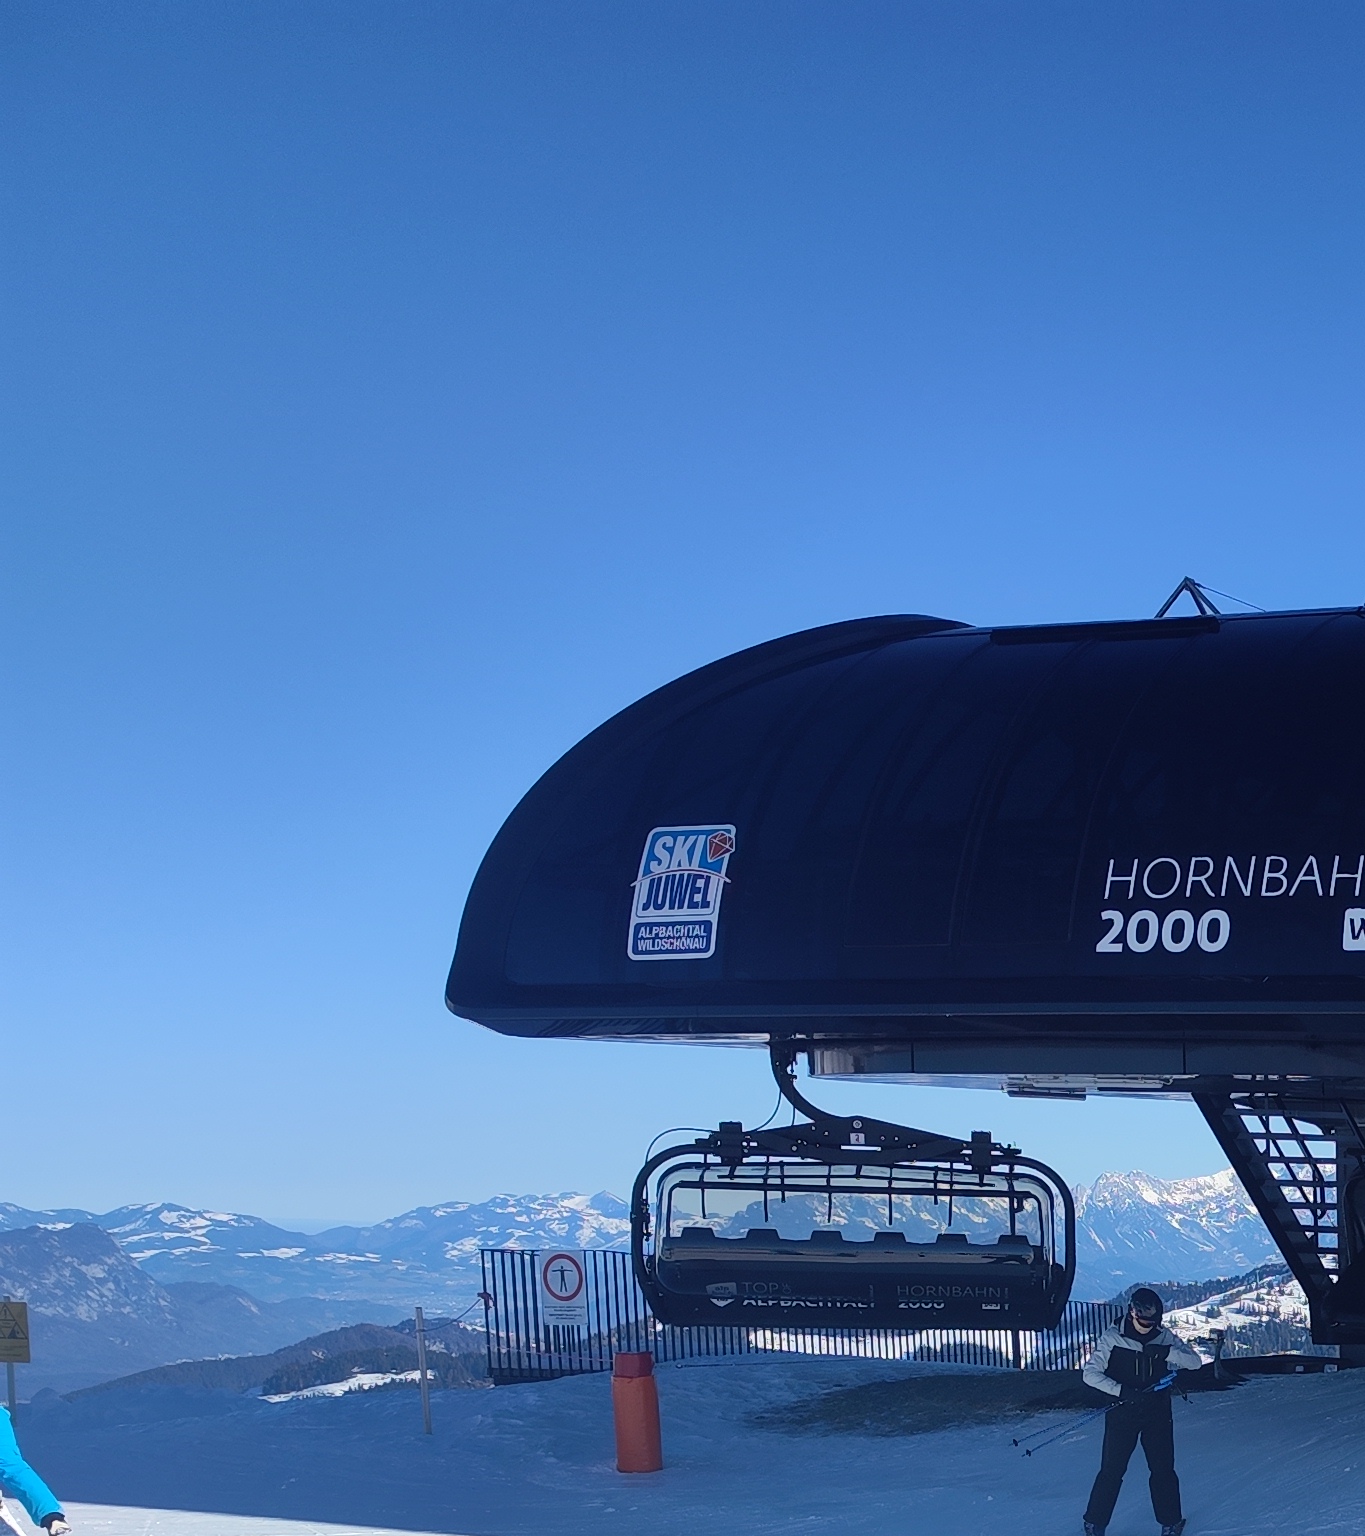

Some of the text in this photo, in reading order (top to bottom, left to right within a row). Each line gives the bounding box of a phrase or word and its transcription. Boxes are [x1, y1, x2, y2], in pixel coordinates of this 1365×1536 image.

[650, 835, 706, 872] SKI
[642, 872, 712, 911] JUWEL
[638, 924, 708, 938] ALPBACHTAL
[1096, 909, 1231, 952] 2000
[637, 937, 707, 951] WILDSCHÖNAU
[741, 1282, 779, 1293] TOP
[897, 1285, 1001, 1298] HORNBAHN
